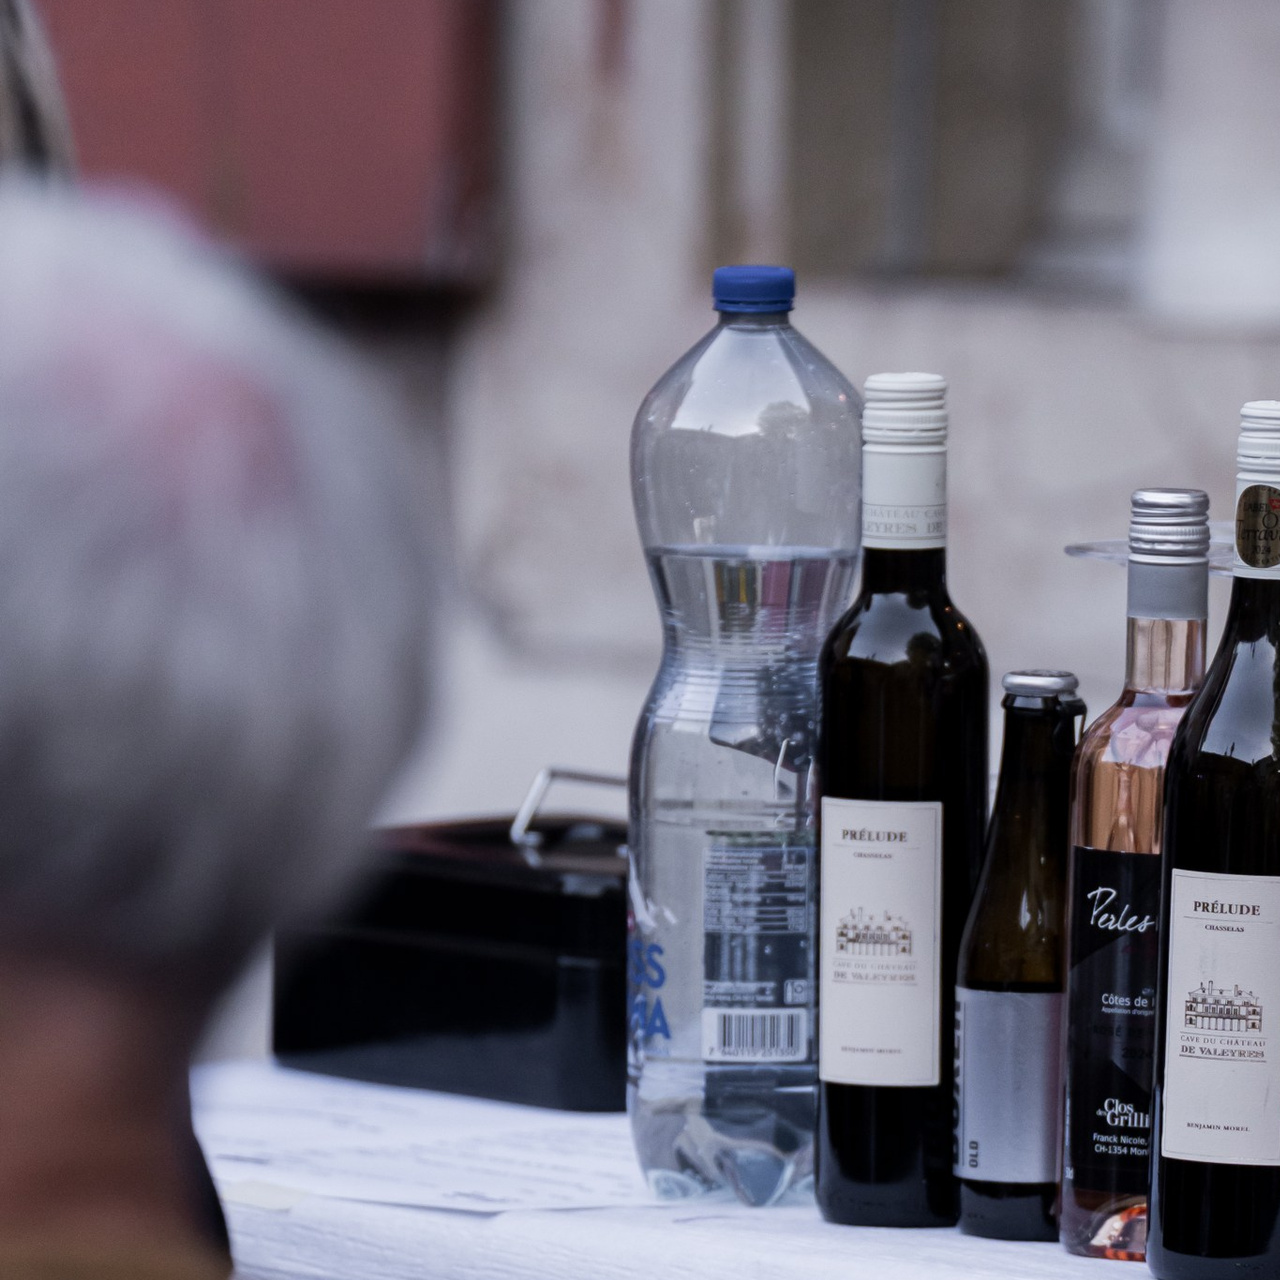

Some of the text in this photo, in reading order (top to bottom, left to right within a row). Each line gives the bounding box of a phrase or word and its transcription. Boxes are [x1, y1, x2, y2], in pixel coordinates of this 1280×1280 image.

[842, 828, 908, 842] PRÉLUDE
[1087, 886, 1155, 933] Perles
[1193, 900, 1261, 916] PRÉLUDE
[1204, 924, 1245, 932] CHASSELAS
[1101, 993, 1131, 1006] Côtes
[1134, 995, 1148, 1008] de
[1181, 1034, 1267, 1047] CAVE DU CHÂTEAU
[1181, 1045, 1265, 1058] DE VALEYRES
[1104, 1098, 1134, 1115] Clos
[1106, 1111, 1150, 1129] Grilli
[1187, 1122, 1250, 1132] BENJAMIN MOREL
[1093, 1132, 1148, 1146] Franck Nicole,
[969, 1140, 979, 1169] OLD
[1094, 1144, 1128, 1155] CH-1354
